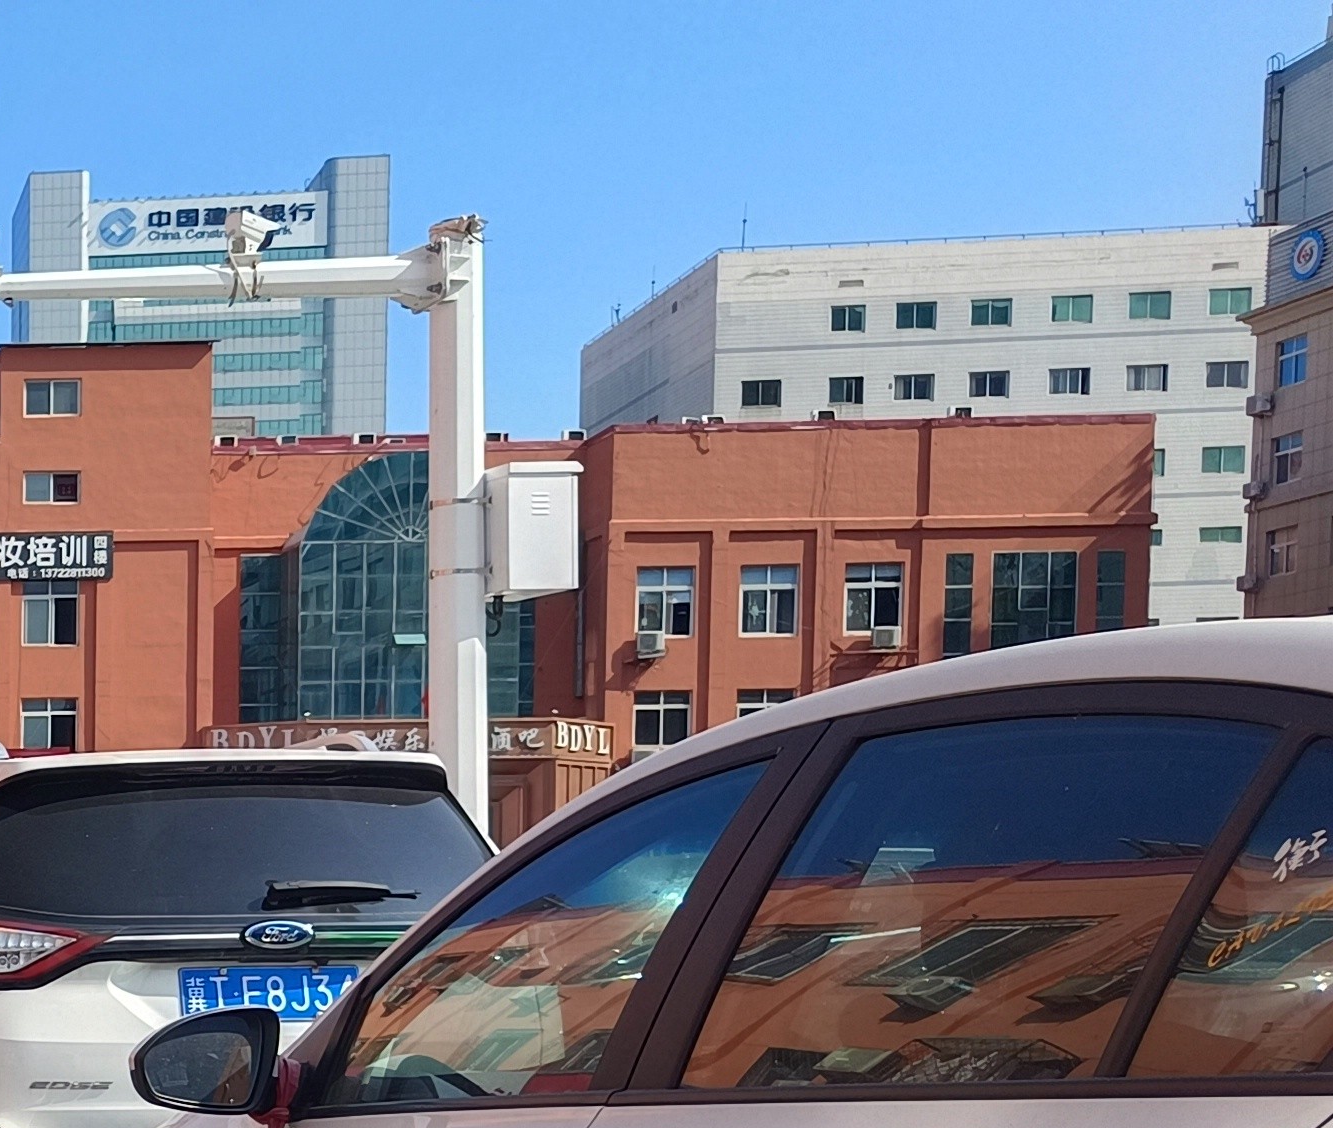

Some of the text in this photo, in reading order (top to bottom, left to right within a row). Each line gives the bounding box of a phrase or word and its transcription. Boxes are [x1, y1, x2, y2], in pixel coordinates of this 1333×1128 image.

[147, 228, 183, 242] China
[555, 720, 611, 755] BDYL
[260, 925, 300, 943] Ford
